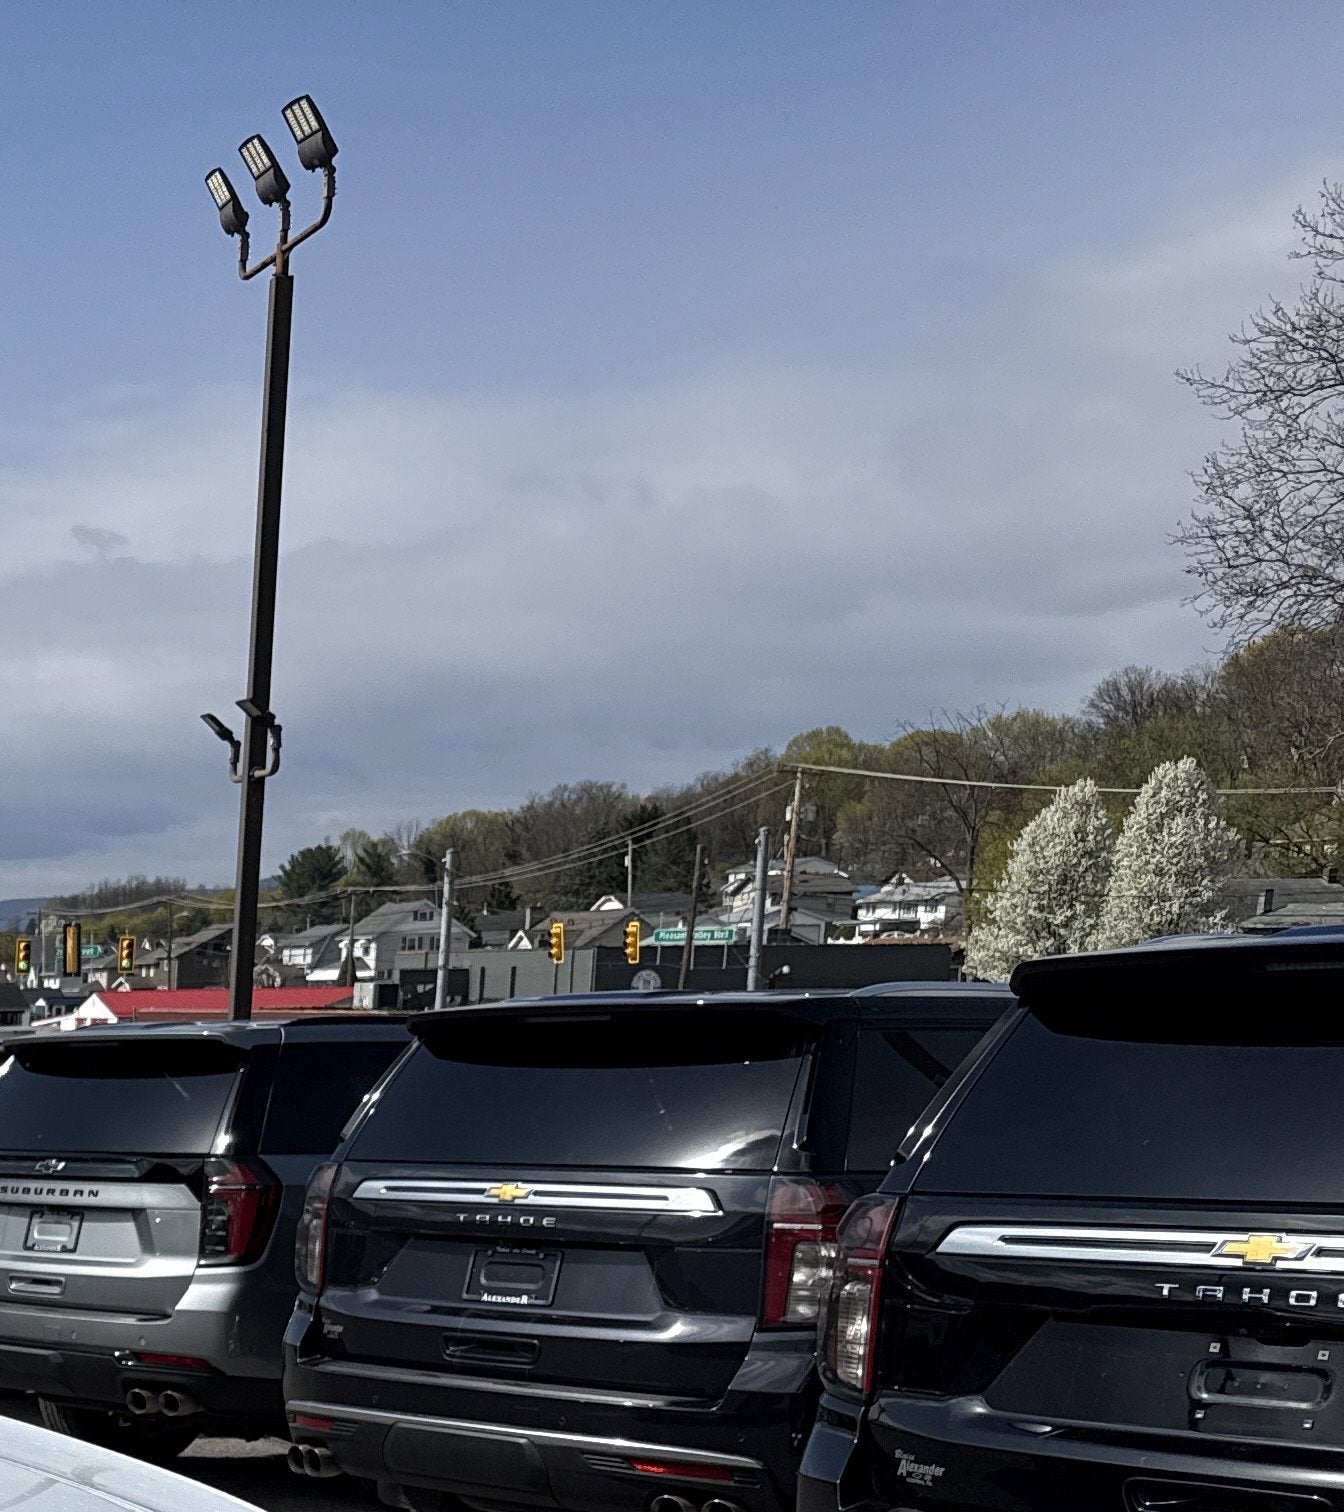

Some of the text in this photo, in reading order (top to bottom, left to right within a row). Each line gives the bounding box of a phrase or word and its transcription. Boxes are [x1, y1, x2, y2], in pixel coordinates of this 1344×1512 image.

[0, 1185, 100, 1198] SUBURBAN
[455, 1213, 557, 1228] TAHOE
[1153, 1282, 1344, 1308] TAHO
[896, 1459, 946, 1477] Alexander
